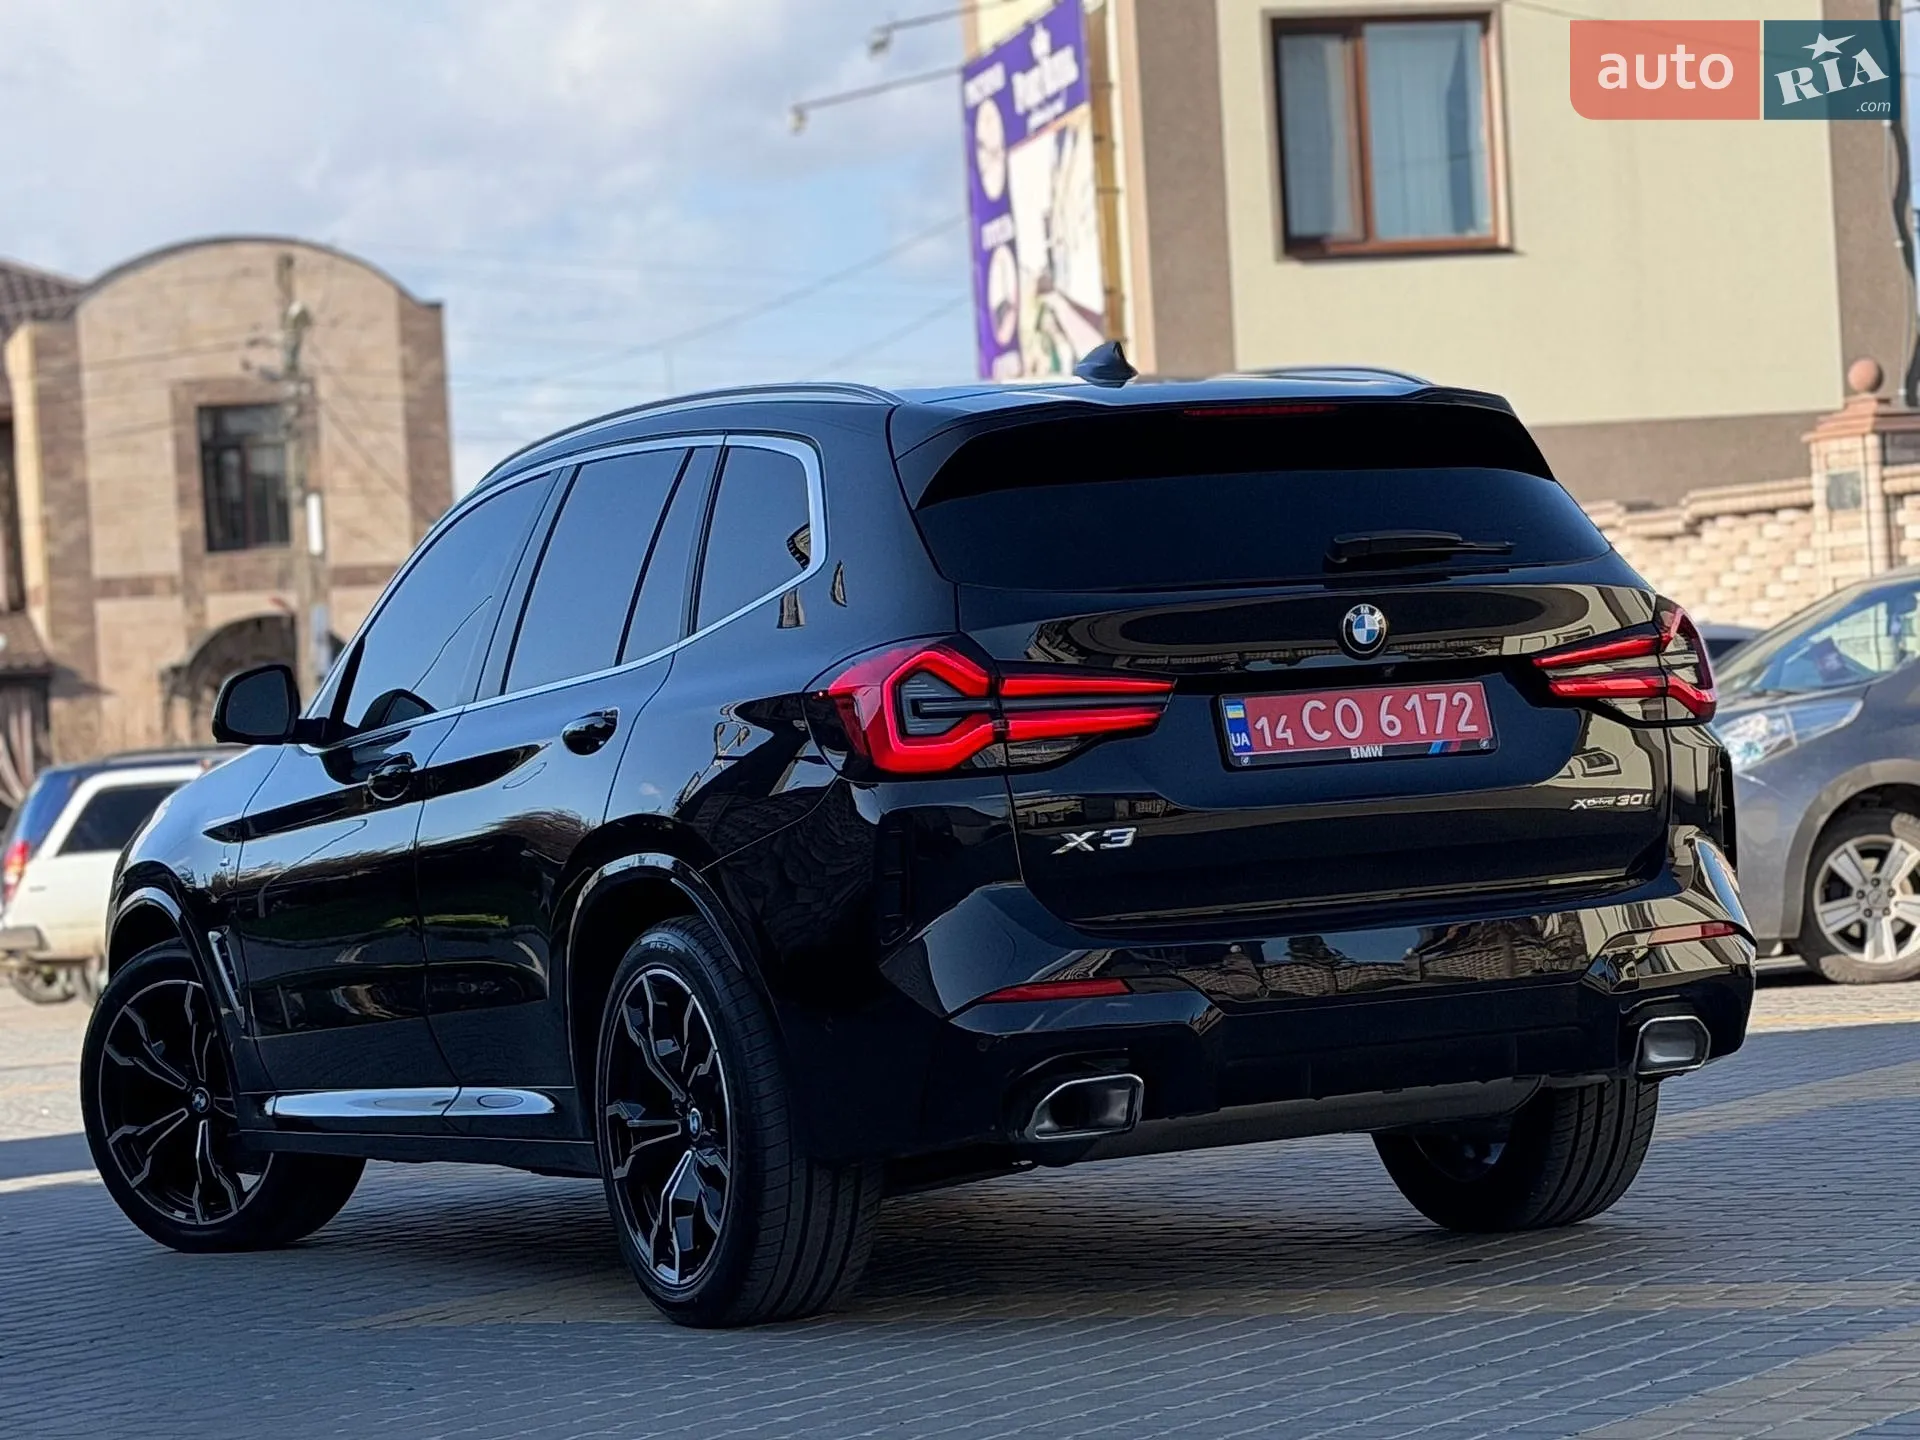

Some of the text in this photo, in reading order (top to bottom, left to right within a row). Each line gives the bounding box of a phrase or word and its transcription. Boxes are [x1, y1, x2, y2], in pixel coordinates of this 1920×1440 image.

[1254, 691, 1479, 748] 14 CO 6172
[1231, 732, 1251, 747] UA
[1350, 744, 1383, 759] BMW
[1051, 827, 1138, 855] X3
